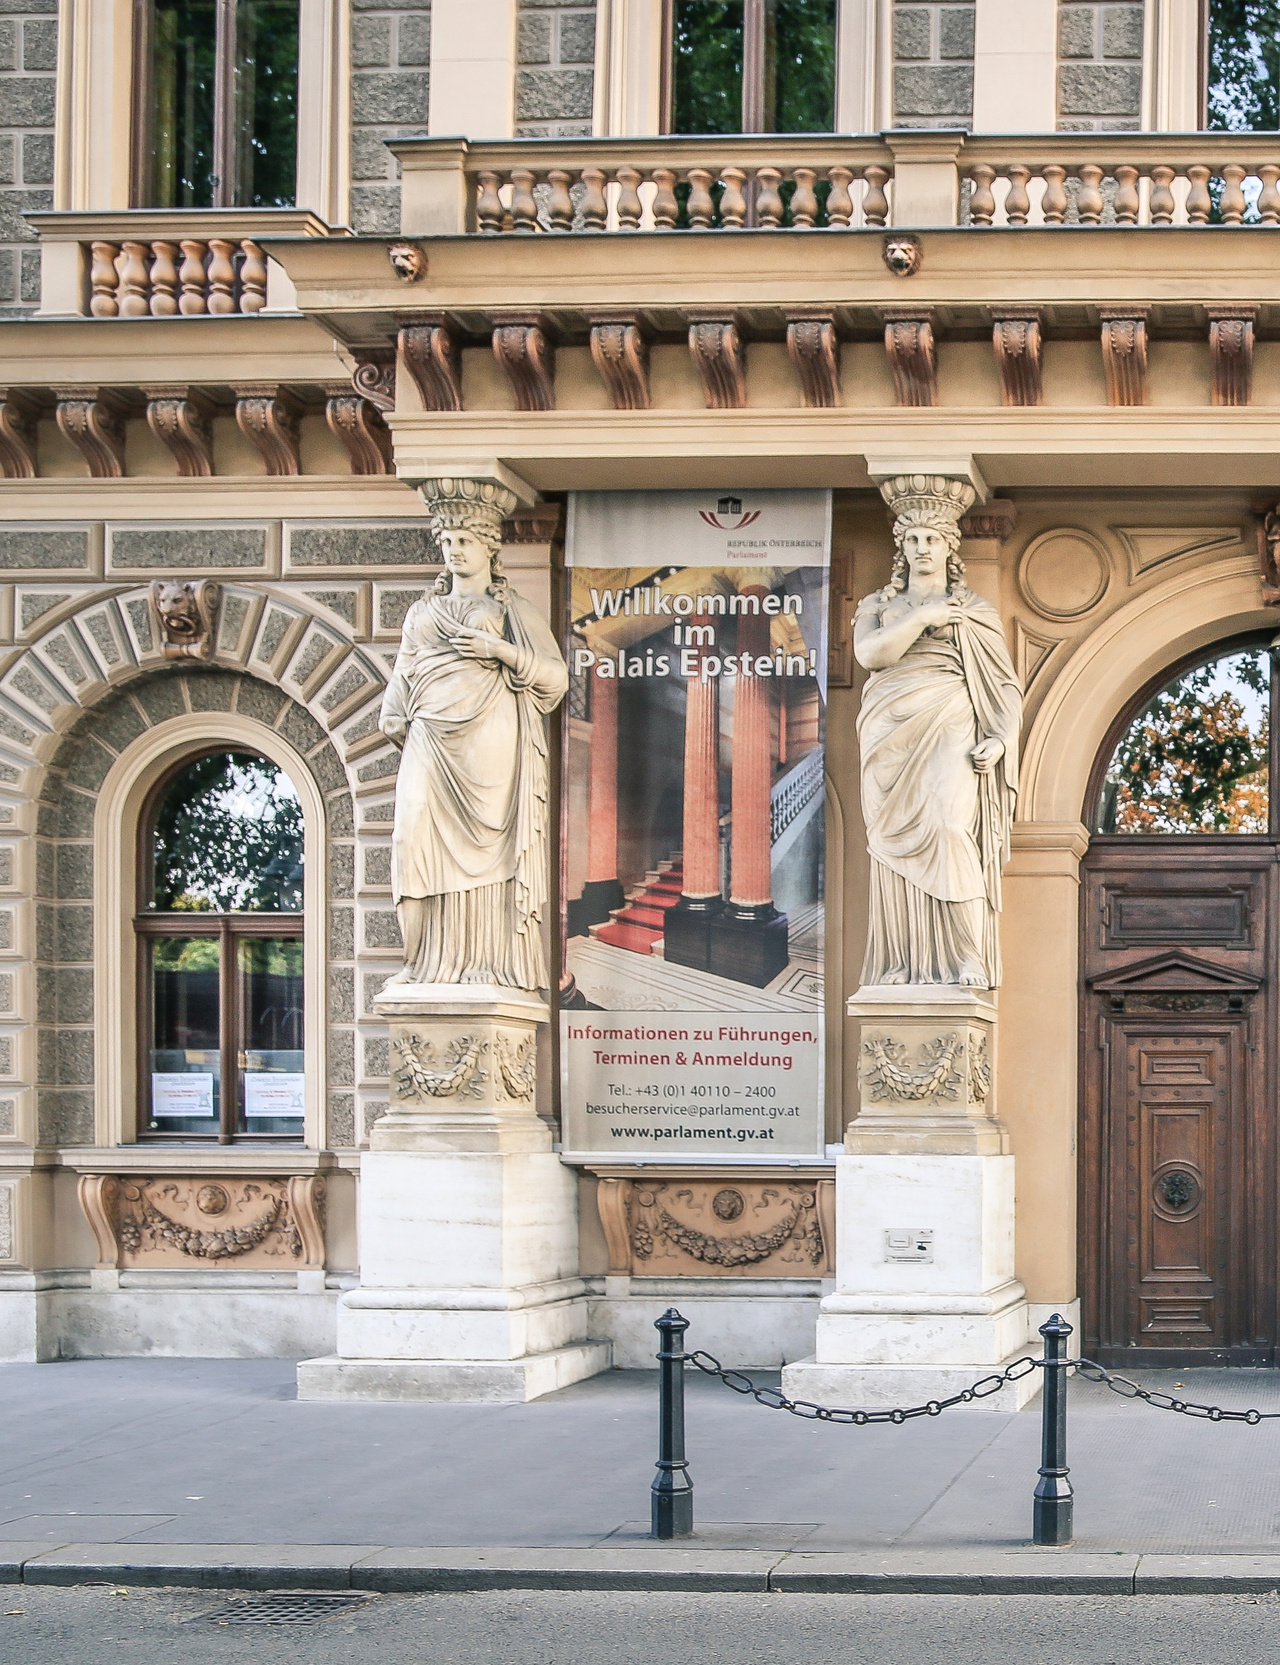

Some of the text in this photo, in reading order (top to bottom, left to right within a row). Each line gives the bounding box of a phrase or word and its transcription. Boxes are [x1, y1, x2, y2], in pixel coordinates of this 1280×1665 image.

[589, 586, 803, 619] Willkommen
[673, 617, 715, 646] im
[573, 648, 817, 685] Palais Epstein!
[567, 1025, 818, 1045] Informationen zu Führungen,
[593, 1051, 793, 1070] Terminen & Anmeldung
[607, 1084, 632, 1096] Tel.:
[635, 1085, 659, 1097] +43
[662, 1084, 685, 1099] (0)1
[690, 1085, 730, 1097] 40110
[745, 1086, 776, 1098] 2400
[586, 1102, 800, 1118] besucherservice@parlament.gv.at
[611, 1126, 774, 1142] www.parlament.gv.at
